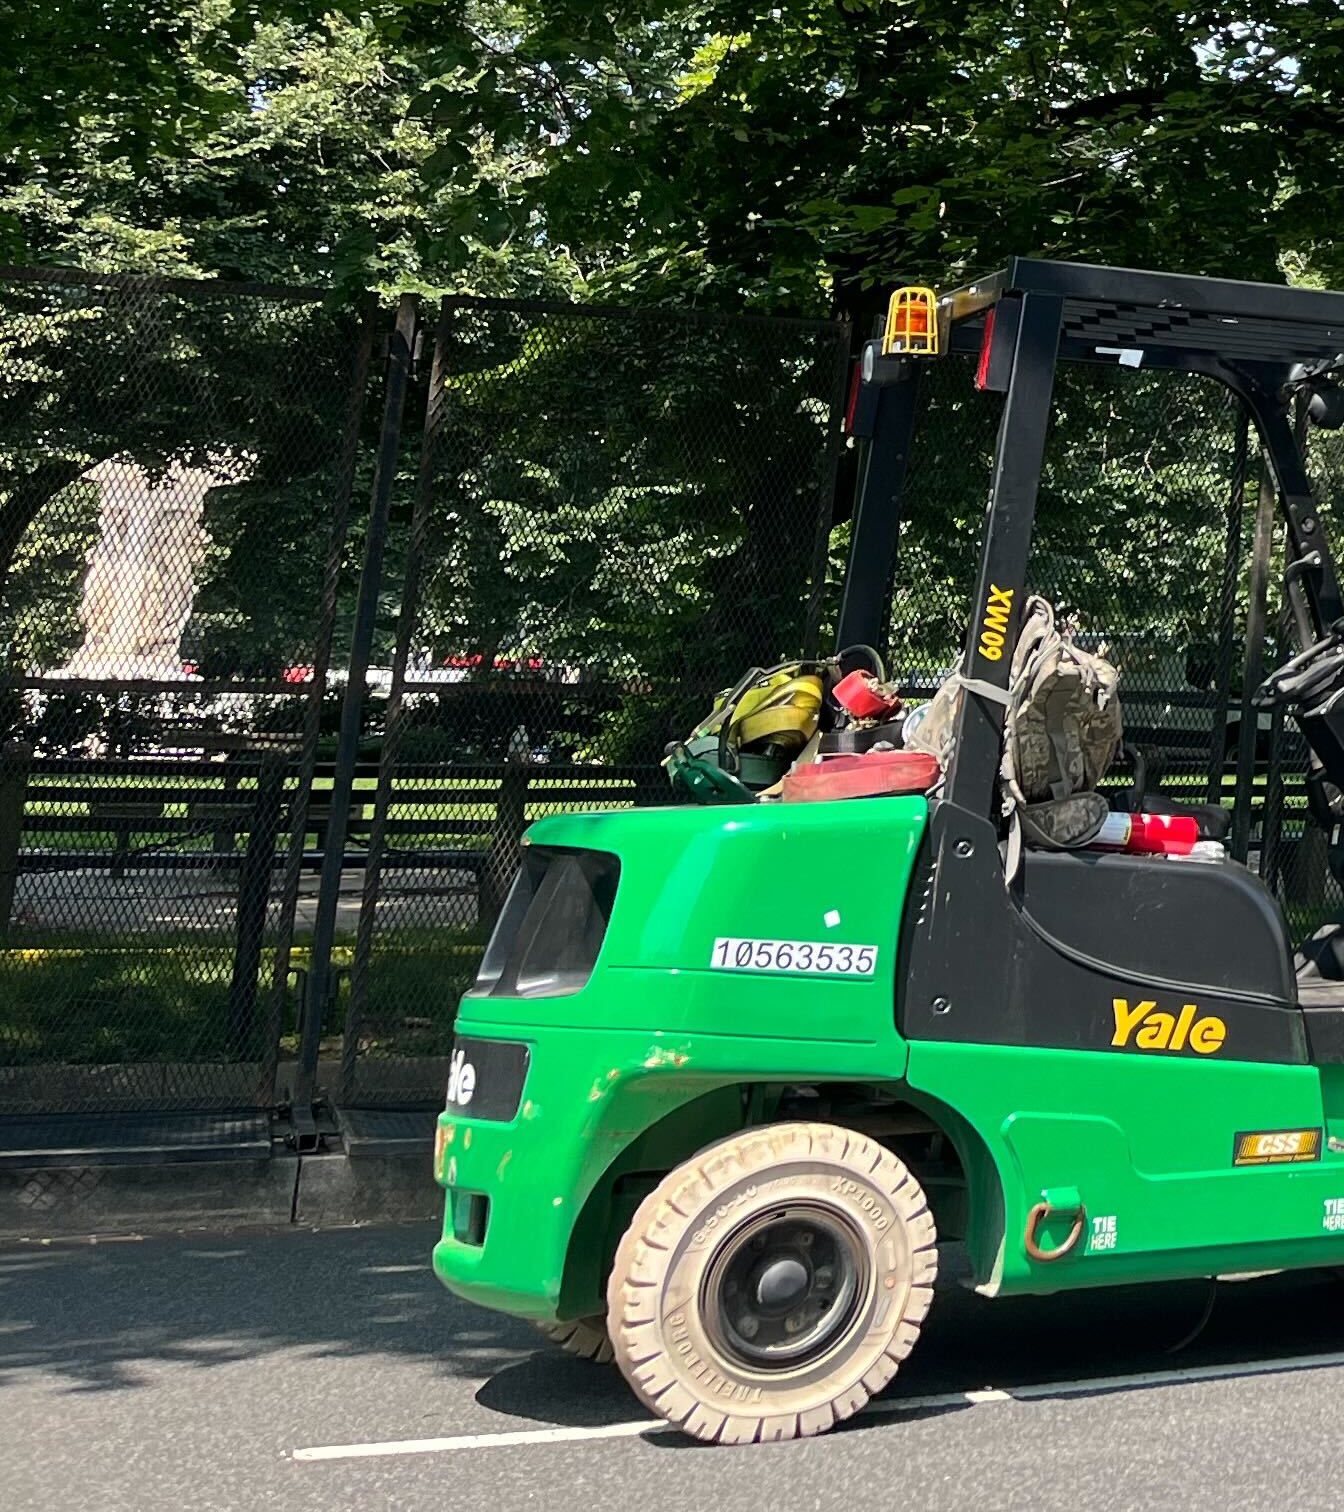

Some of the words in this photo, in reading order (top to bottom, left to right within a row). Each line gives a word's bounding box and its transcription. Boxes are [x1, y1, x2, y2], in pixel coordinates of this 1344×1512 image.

[979, 583, 1014, 661] 60MX
[717, 940, 875, 974] 10563535
[1111, 998, 1226, 1055] Yale
[1257, 1133, 1300, 1156] CSS
[831, 1176, 889, 1232] XP1000
[1092, 1215, 1117, 1233] TIE
[1090, 1232, 1117, 1251] HERE
[669, 1312, 763, 1405] TRELLEBORG
